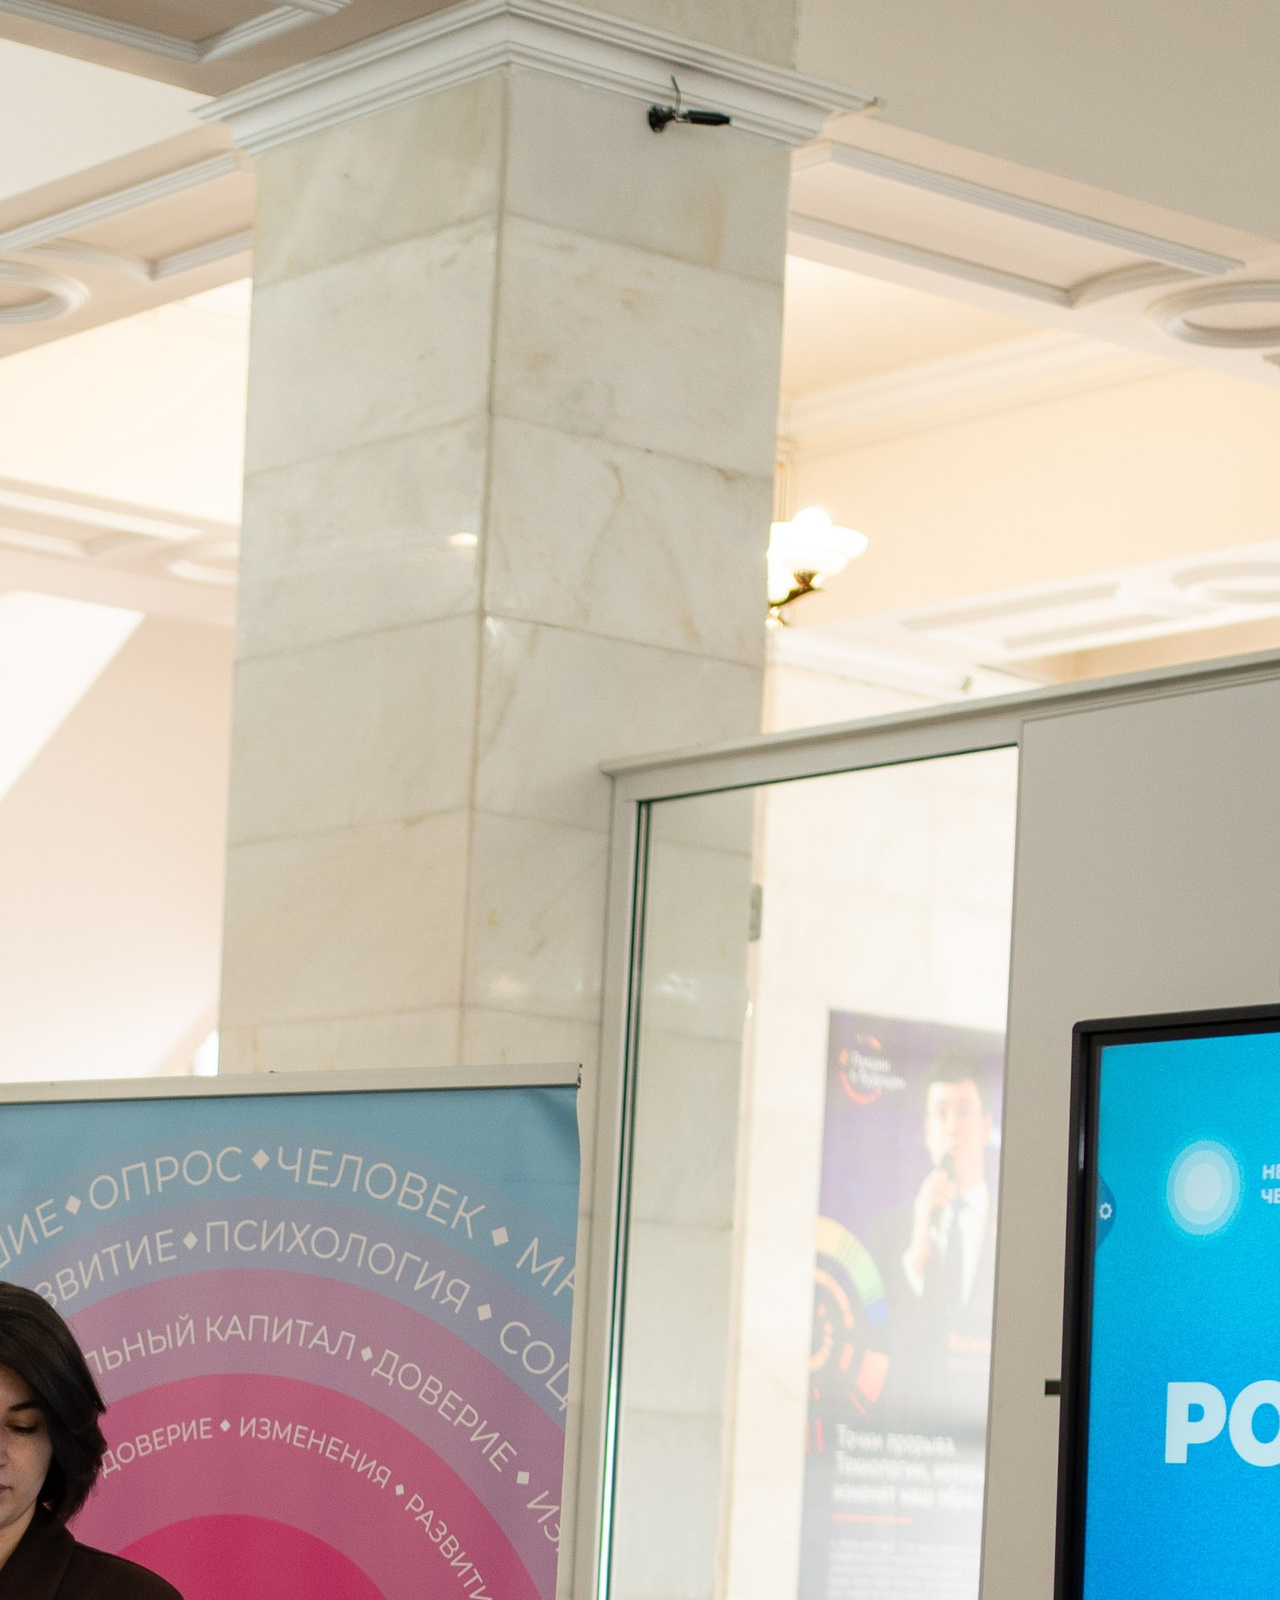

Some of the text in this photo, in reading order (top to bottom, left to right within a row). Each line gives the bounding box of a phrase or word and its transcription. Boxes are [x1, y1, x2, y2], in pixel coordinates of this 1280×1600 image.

[89, 1146, 242, 1211] ОПРОС
[276, 1147, 486, 1239] ЧЕЛОВЕК
[207, 1219, 471, 1315] ПСИХОЛОГИЯ
[206, 1314, 357, 1361] КАПИТАЛ
[371, 1348, 518, 1473] ДОВЕРИЕ
[101, 1416, 213, 1479] ДОВЕРИЕ
[239, 1415, 392, 1489] ИЗМЕНЕНИЯ
